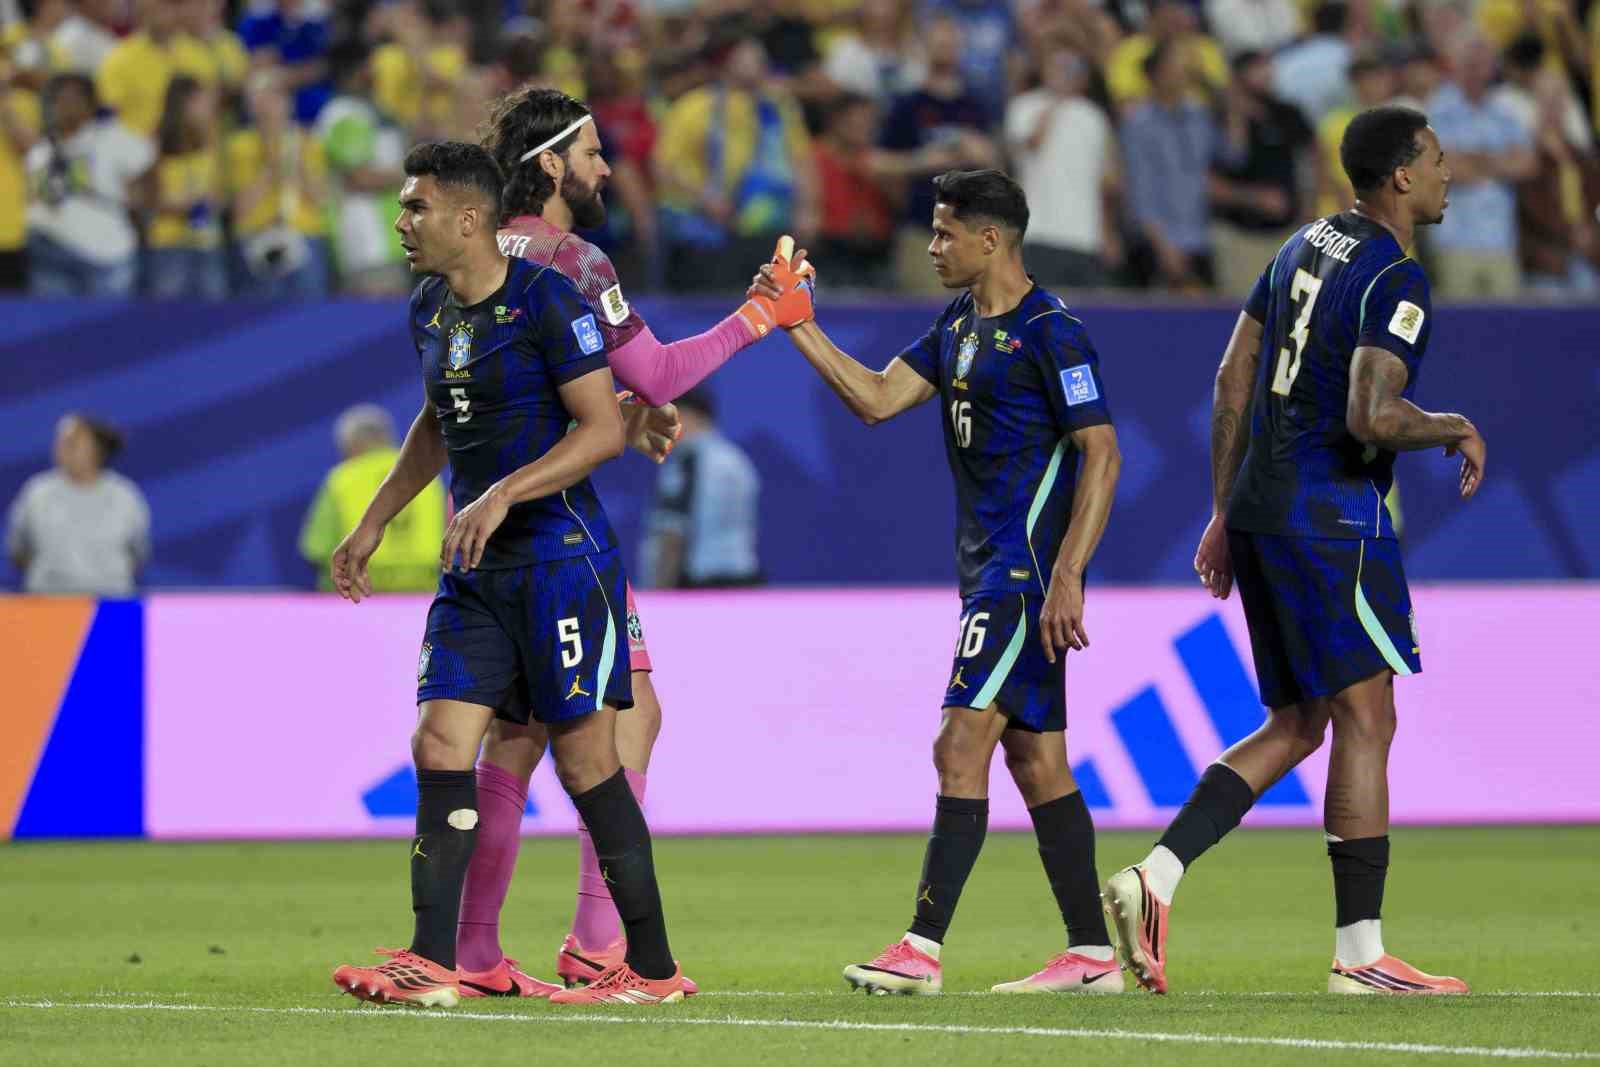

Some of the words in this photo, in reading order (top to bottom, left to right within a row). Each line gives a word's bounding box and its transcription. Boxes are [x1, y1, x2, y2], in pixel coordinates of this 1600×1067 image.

[1271, 267, 1323, 396] 3
[450, 387, 472, 423] 5
[951, 400, 972, 448] 16
[557, 616, 583, 668] 5
[955, 611, 990, 658] 16
